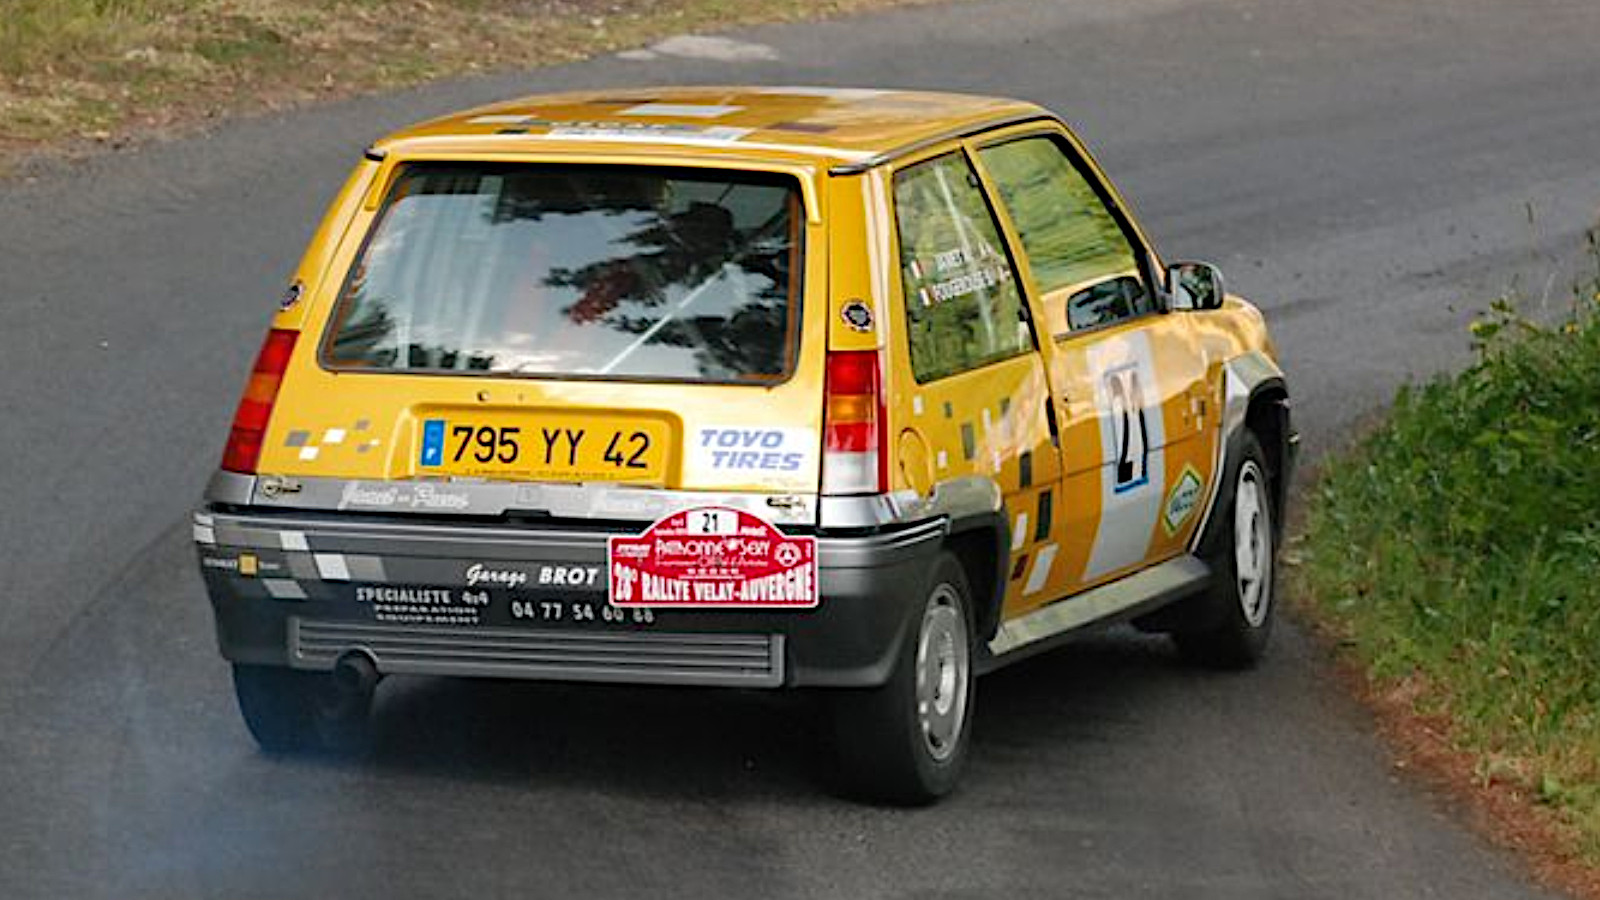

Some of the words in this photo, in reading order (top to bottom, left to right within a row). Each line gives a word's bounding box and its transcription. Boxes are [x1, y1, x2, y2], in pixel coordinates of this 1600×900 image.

[1110, 370, 1148, 484] 21
[452, 425, 521, 464] 795
[541, 427, 586, 466] YY
[603, 430, 652, 469] 42
[700, 428, 785, 449] TOYO
[712, 450, 804, 472] TIRES
[702, 512, 718, 533] 21
[466, 563, 527, 589] Garage
[538, 565, 599, 586] BROT
[641, 570, 691, 602] RALLYE
[692, 562, 812, 602] VELAY-AUVERGNE
[356, 587, 452, 605] SPECIALISTE
[511, 600, 535, 618] 04
[540, 601, 563, 619] 77
[572, 603, 595, 621] 54
